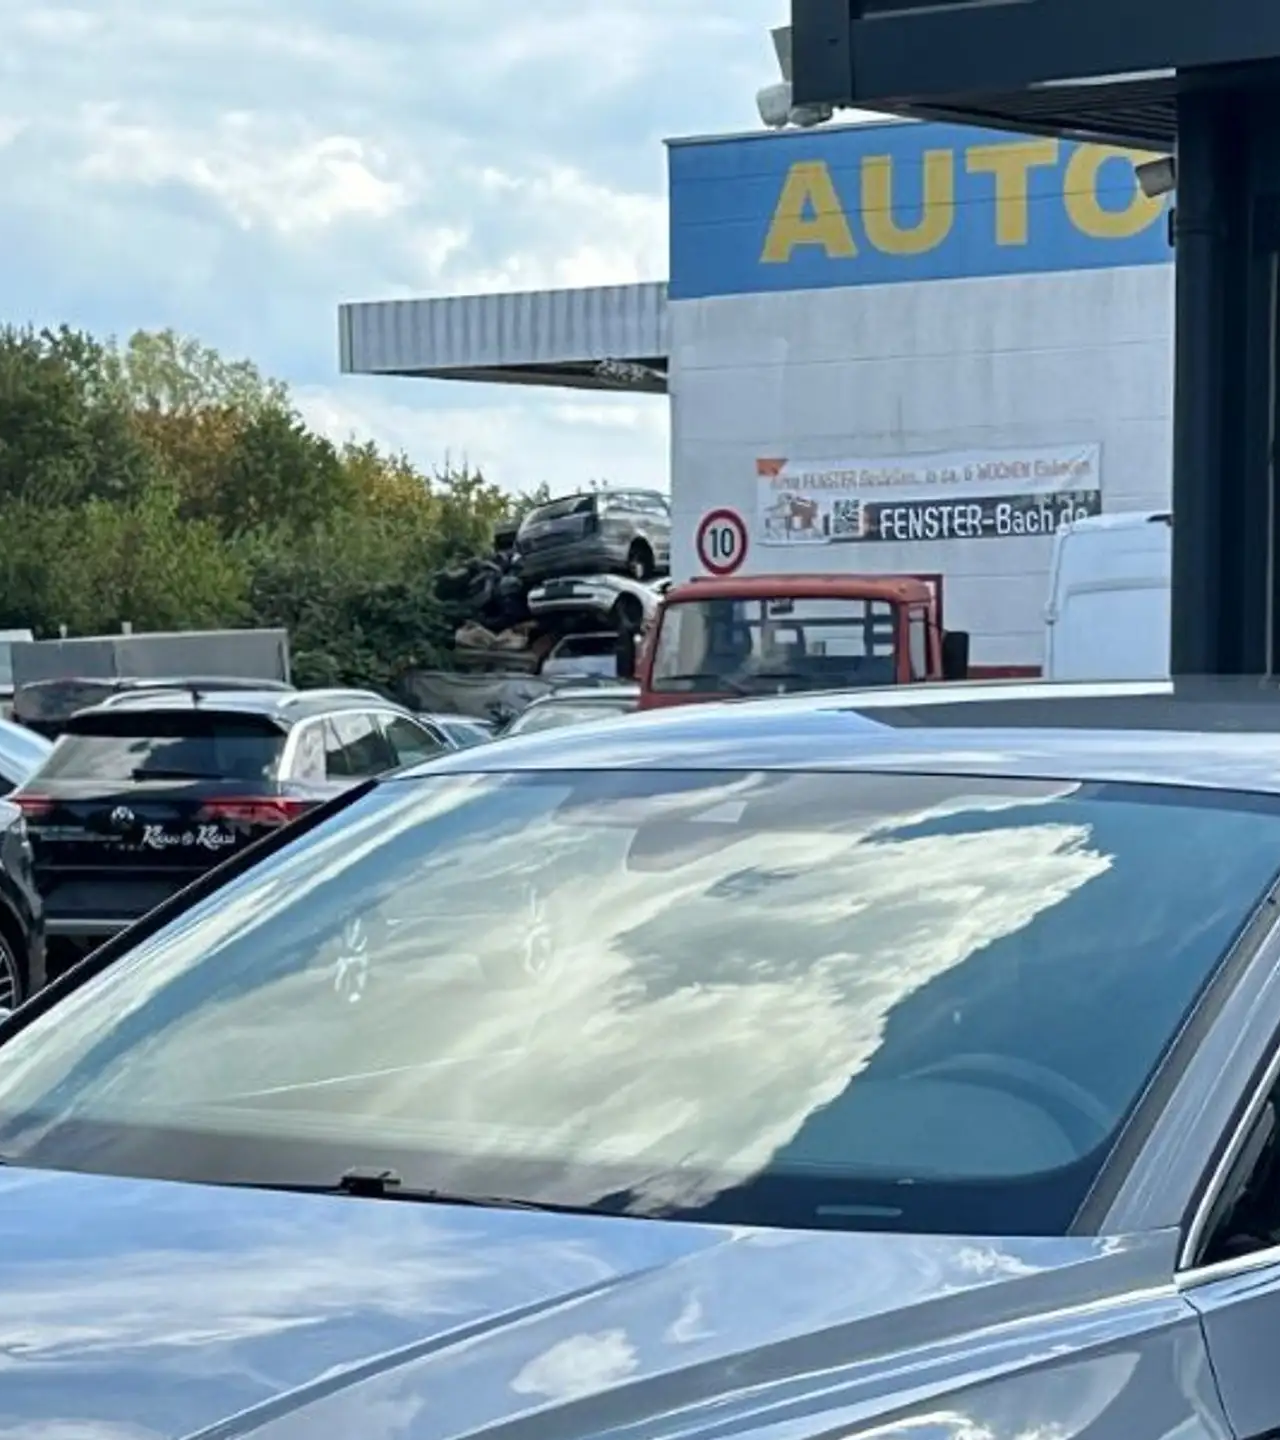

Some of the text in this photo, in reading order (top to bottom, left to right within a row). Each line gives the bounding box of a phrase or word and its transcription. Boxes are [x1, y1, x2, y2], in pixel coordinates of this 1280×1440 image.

[759, 137, 1170, 264] AUTO
[879, 502, 1088, 540] FENSTER-Bachde
[709, 527, 734, 558] 10
